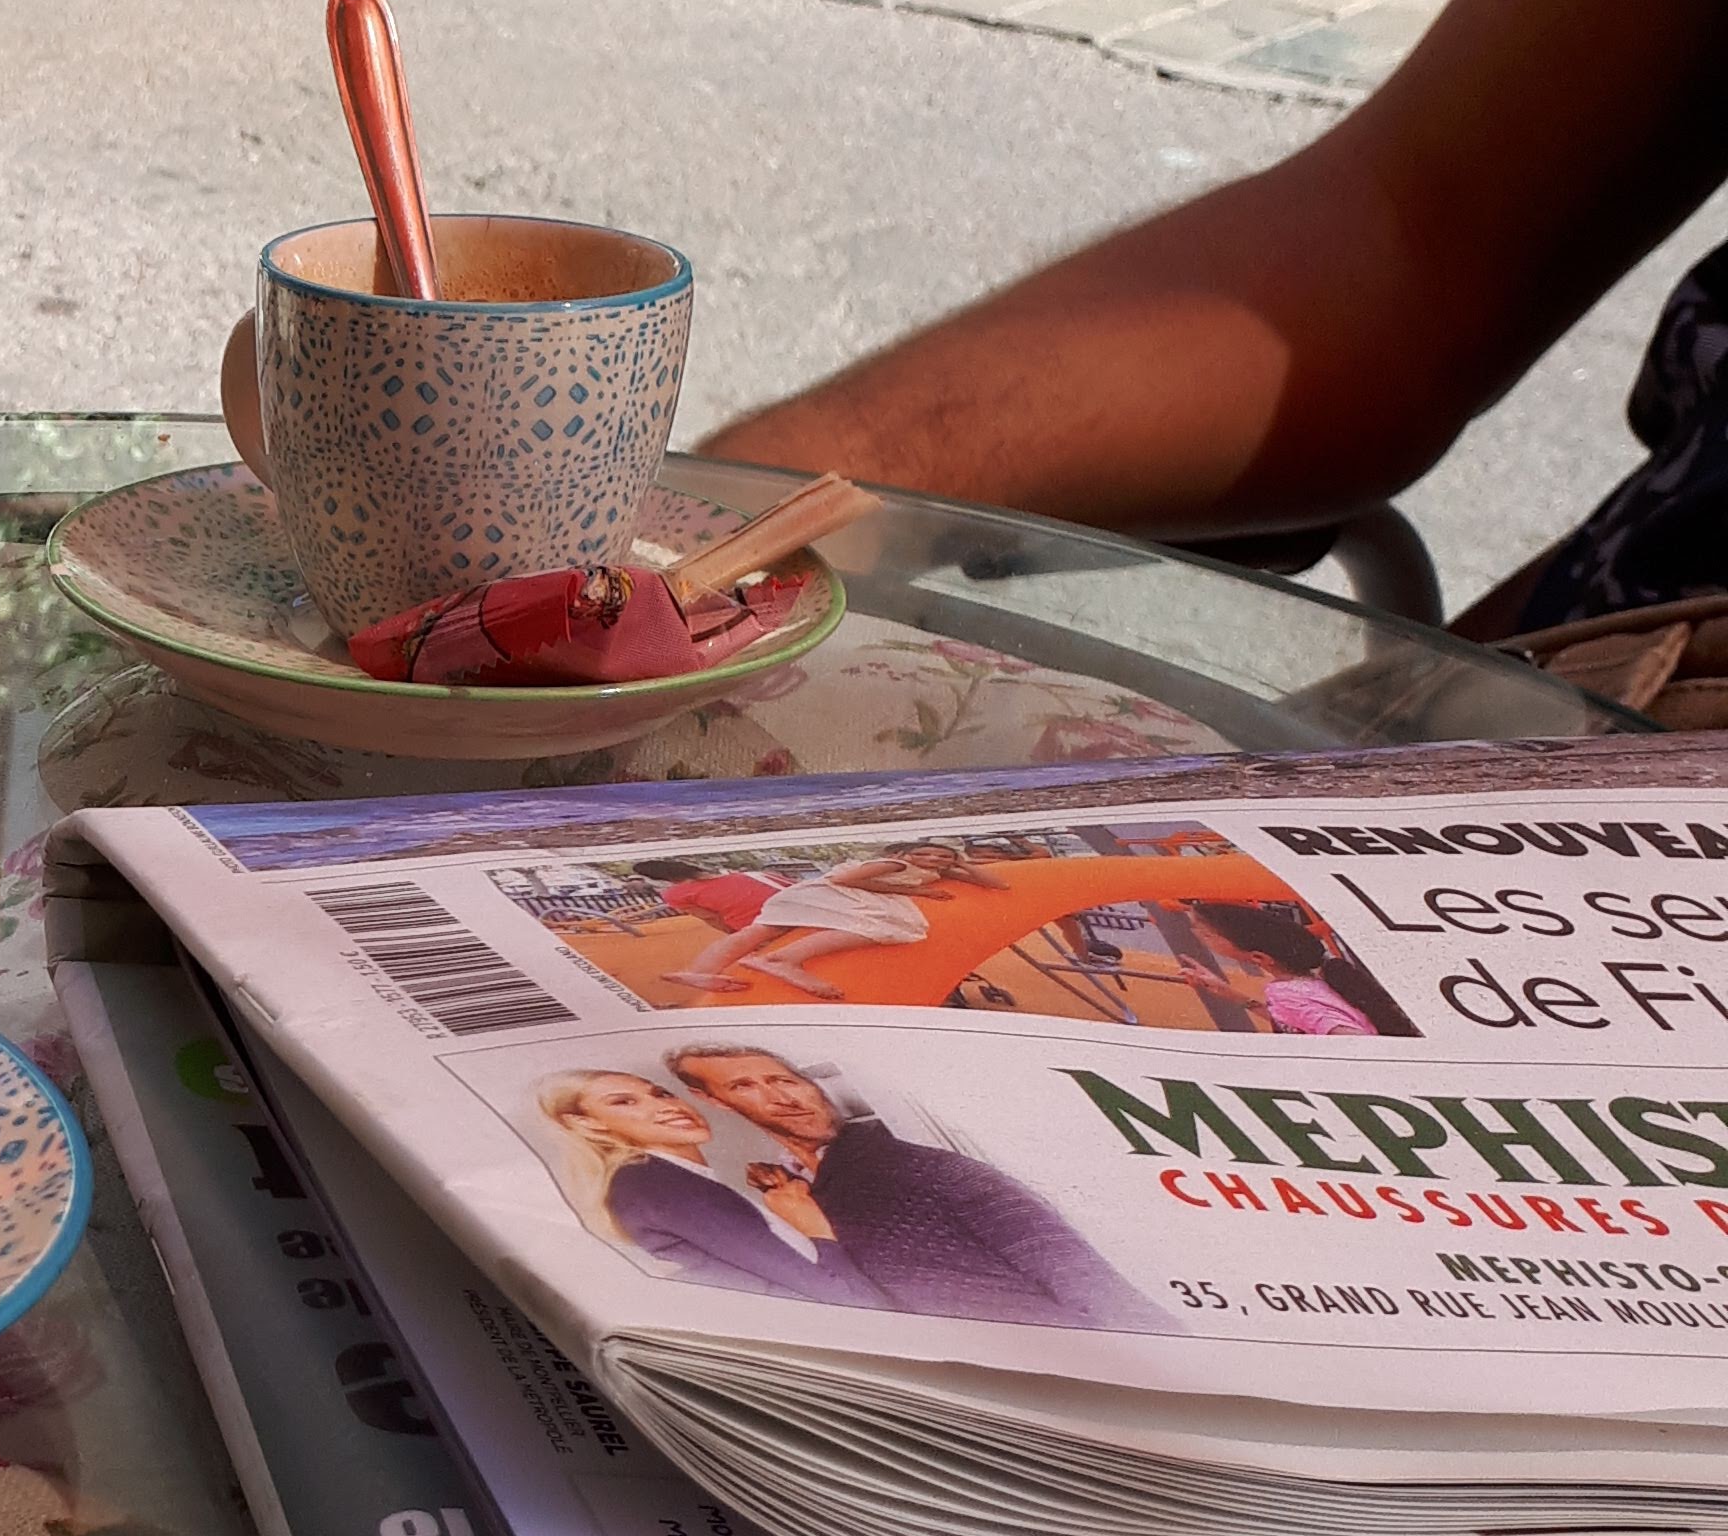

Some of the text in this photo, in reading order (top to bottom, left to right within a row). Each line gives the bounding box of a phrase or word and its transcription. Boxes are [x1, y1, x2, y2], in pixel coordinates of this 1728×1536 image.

[1259, 821, 1728, 860] RENOUVEA
[1331, 873, 1728, 942] Les se
[1440, 958, 1611, 1030] de
[1157, 1169, 1670, 1237] CHAUSSURES
[1260, 1282, 1400, 1317] GRAND
[1406, 1288, 1497, 1319] RUE
[1500, 1293, 1603, 1323] JEAN
[1603, 1297, 1728, 1329] MOULI
[1435, 1252, 1728, 1292] MEPHISTO-
[528, 1358, 585, 1436] MONTPELLIER
[565, 1380, 629, 1456] SAUREL
